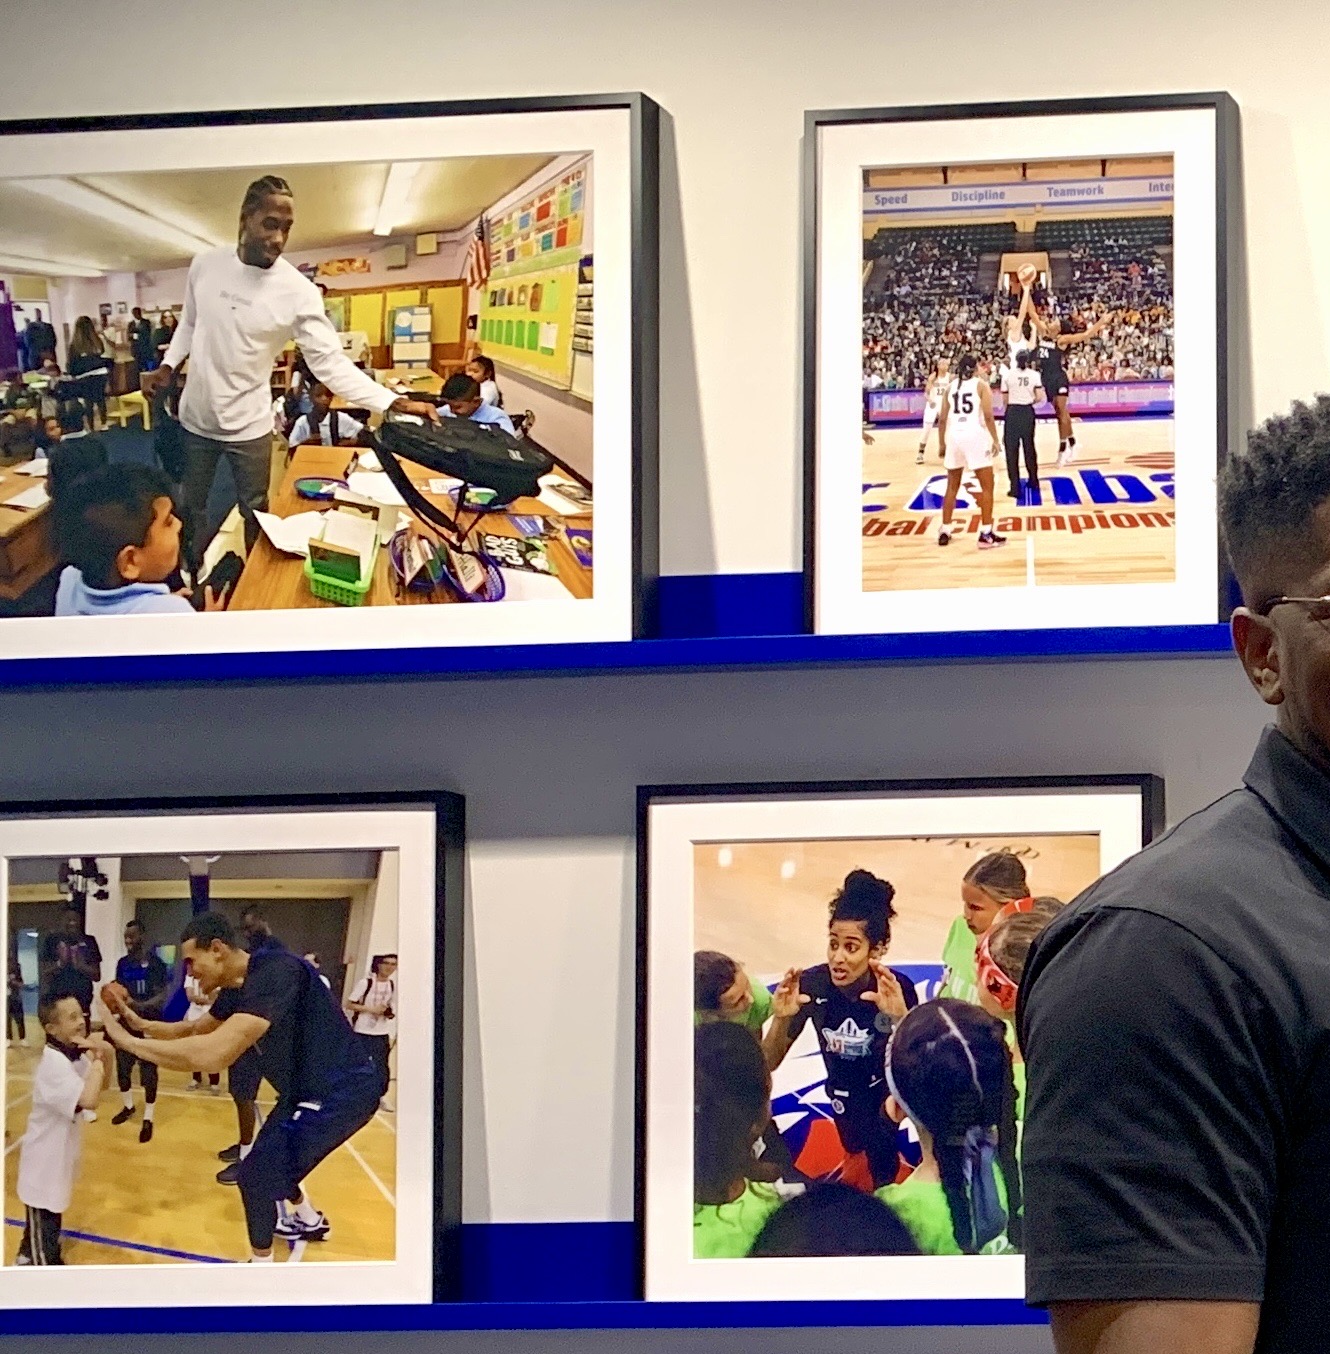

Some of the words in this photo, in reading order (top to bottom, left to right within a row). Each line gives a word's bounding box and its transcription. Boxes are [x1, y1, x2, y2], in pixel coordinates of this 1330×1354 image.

[874, 194, 908, 206] Speed
[951, 189, 1006, 203] Discipline
[1047, 184, 1104, 198] Teamwork
[952, 392, 973, 414] 15
